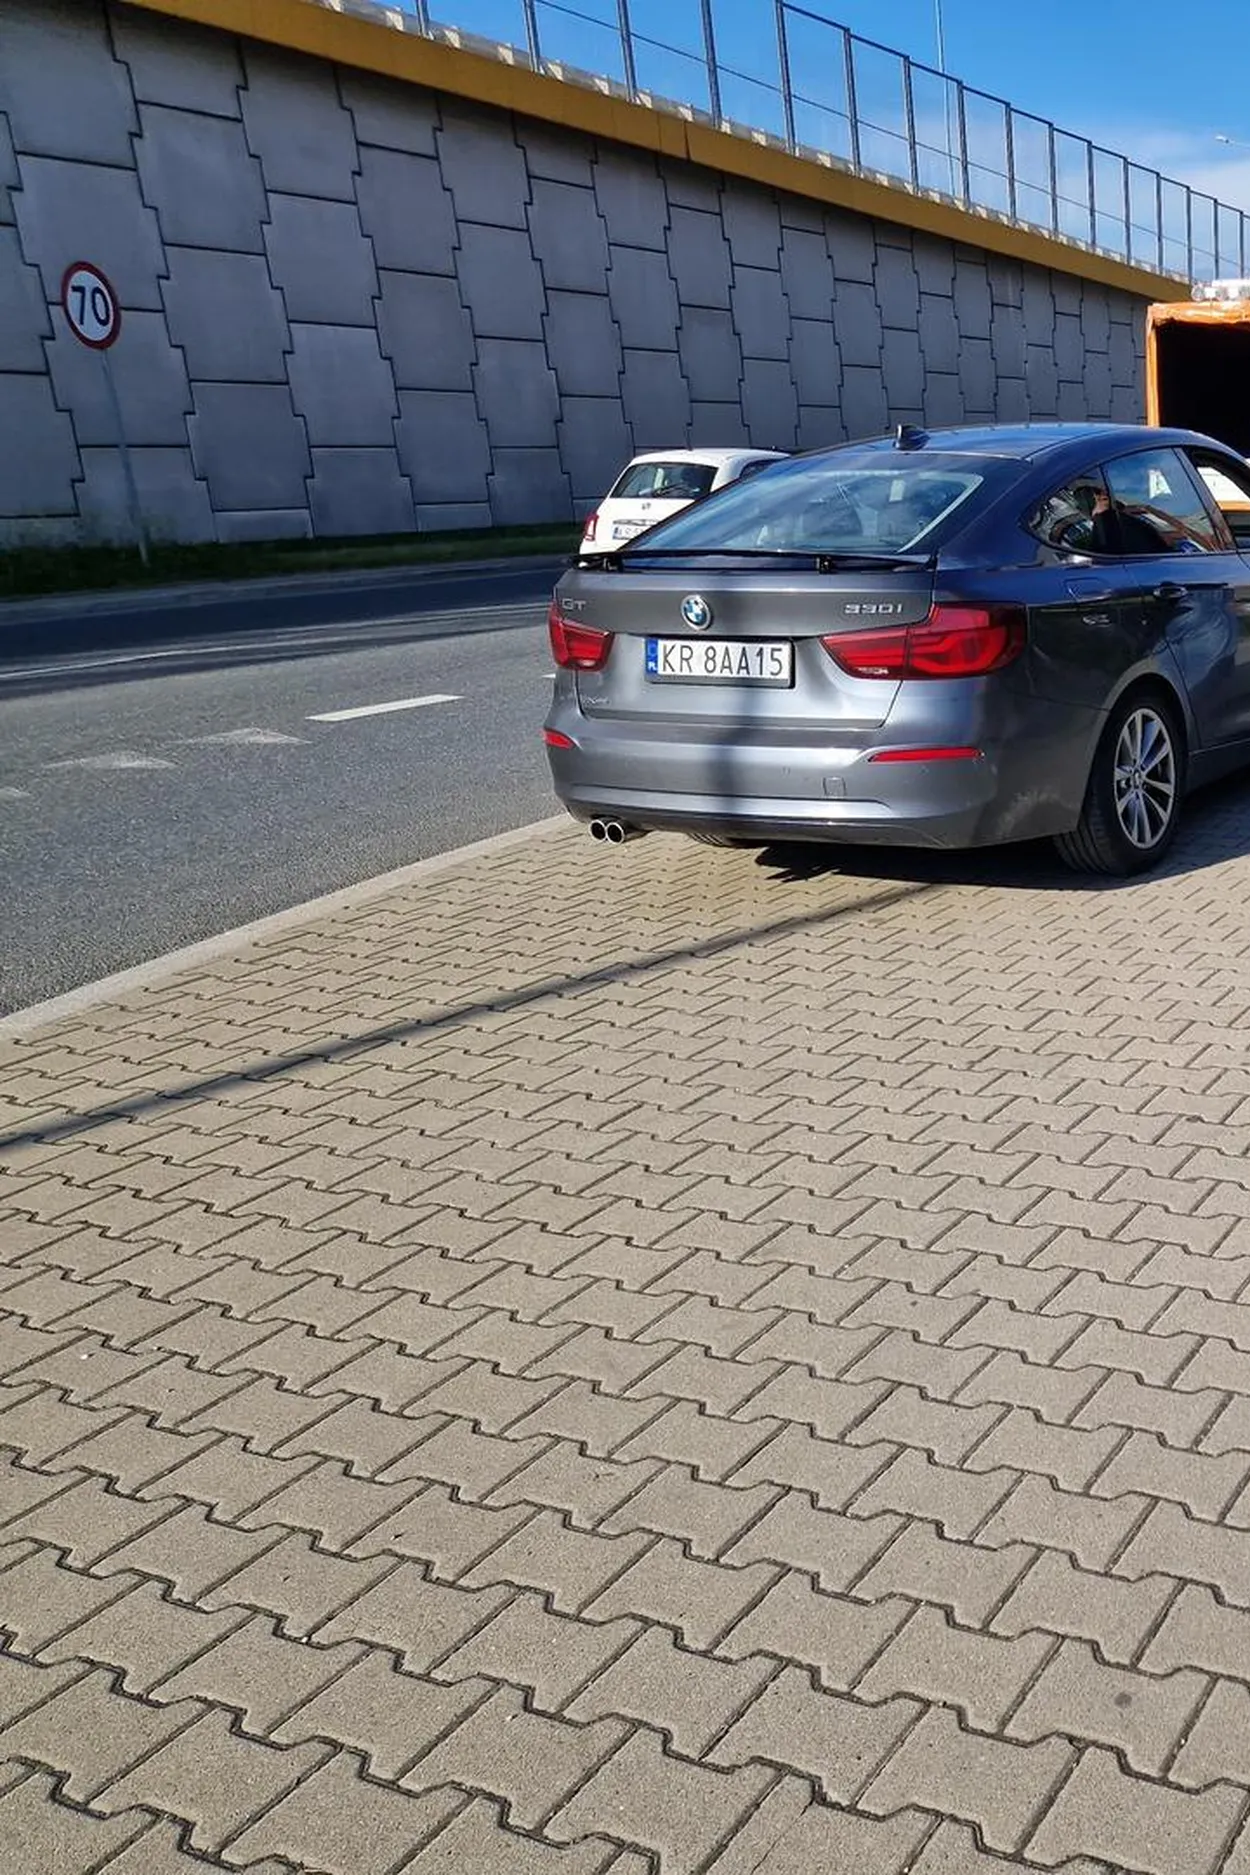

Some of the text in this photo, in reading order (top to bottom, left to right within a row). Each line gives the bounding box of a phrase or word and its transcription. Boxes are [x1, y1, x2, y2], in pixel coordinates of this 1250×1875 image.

[71, 285, 110, 327] 70
[562, 598, 586, 610] GT
[662, 644, 783, 677] KR 8AA15
